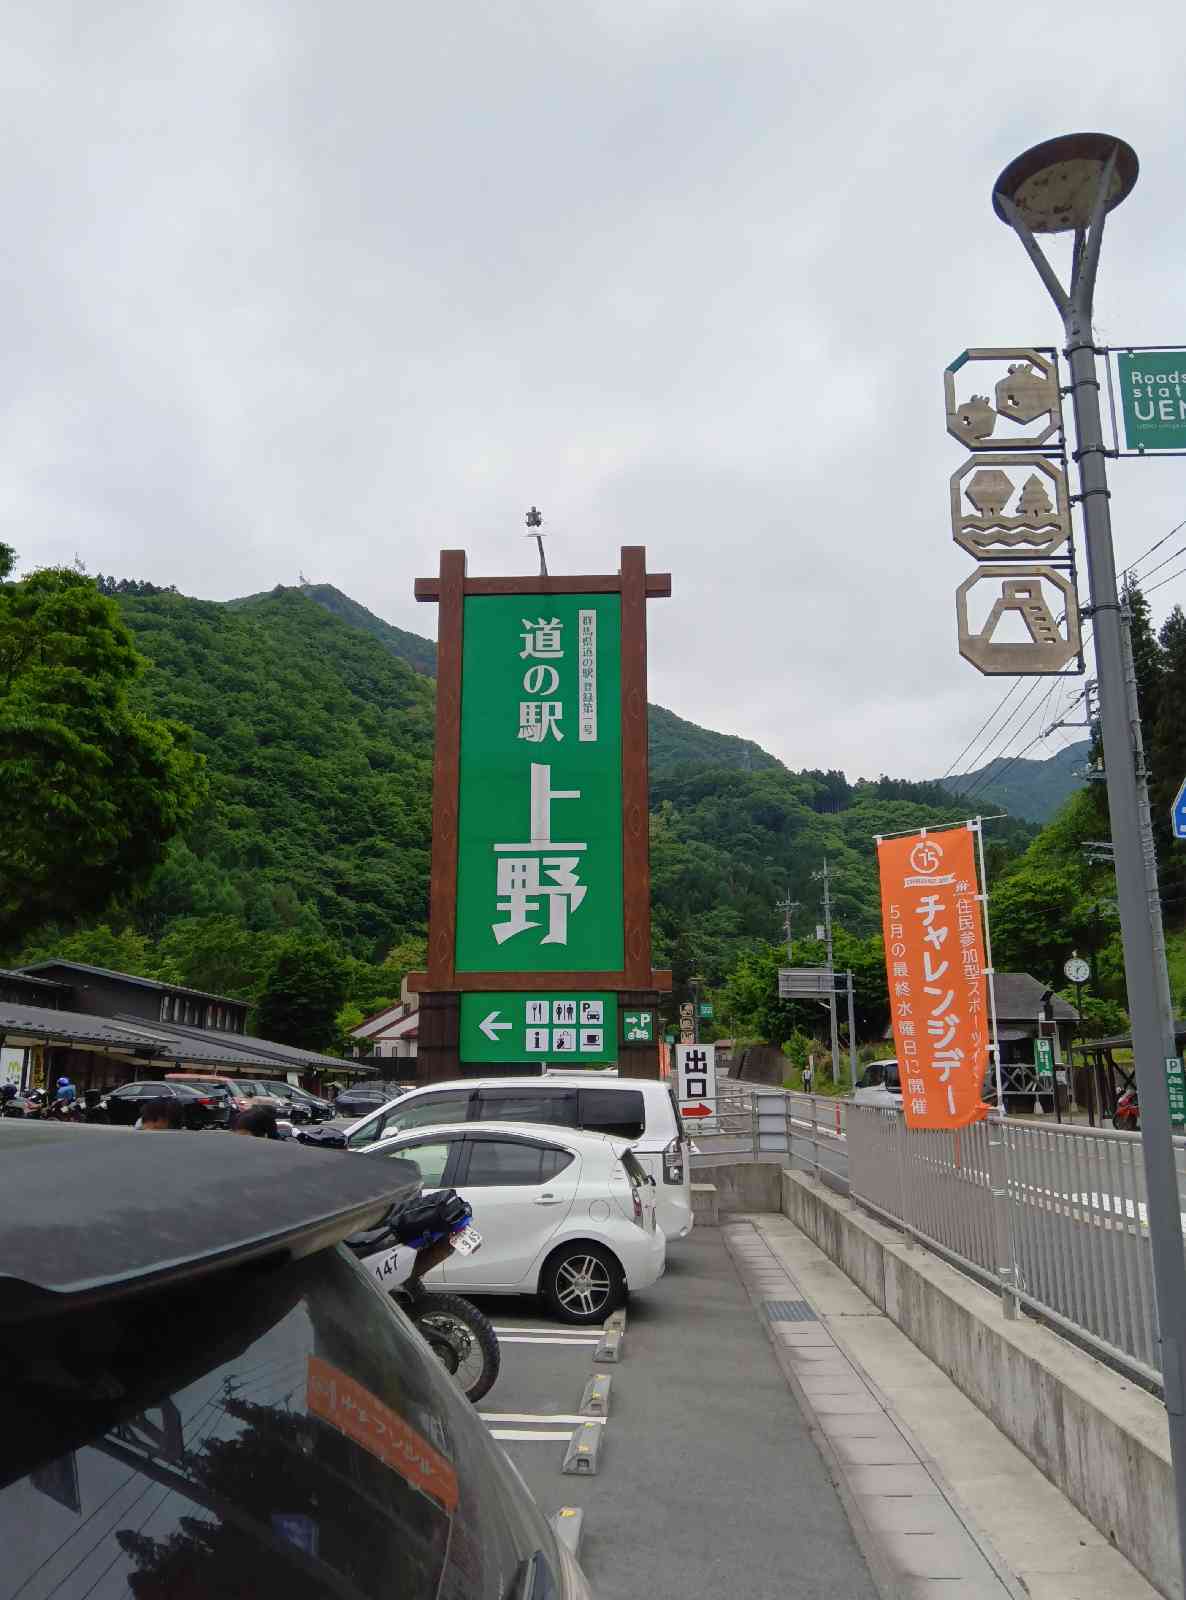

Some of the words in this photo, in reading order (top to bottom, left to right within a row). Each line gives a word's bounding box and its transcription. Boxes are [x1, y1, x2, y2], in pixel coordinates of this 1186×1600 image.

[517, 617, 564, 742] 道の駅
[492, 763, 587, 945] 上野
[583, 1003, 590, 1012] P
[640, 1013, 650, 1027] P
[914, 894, 966, 1115] チャレンジデー
[684, 1049, 707, 1098] 出口
[1169, 1060, 1178, 1071] P
[375, 1254, 398, 1281] 147
